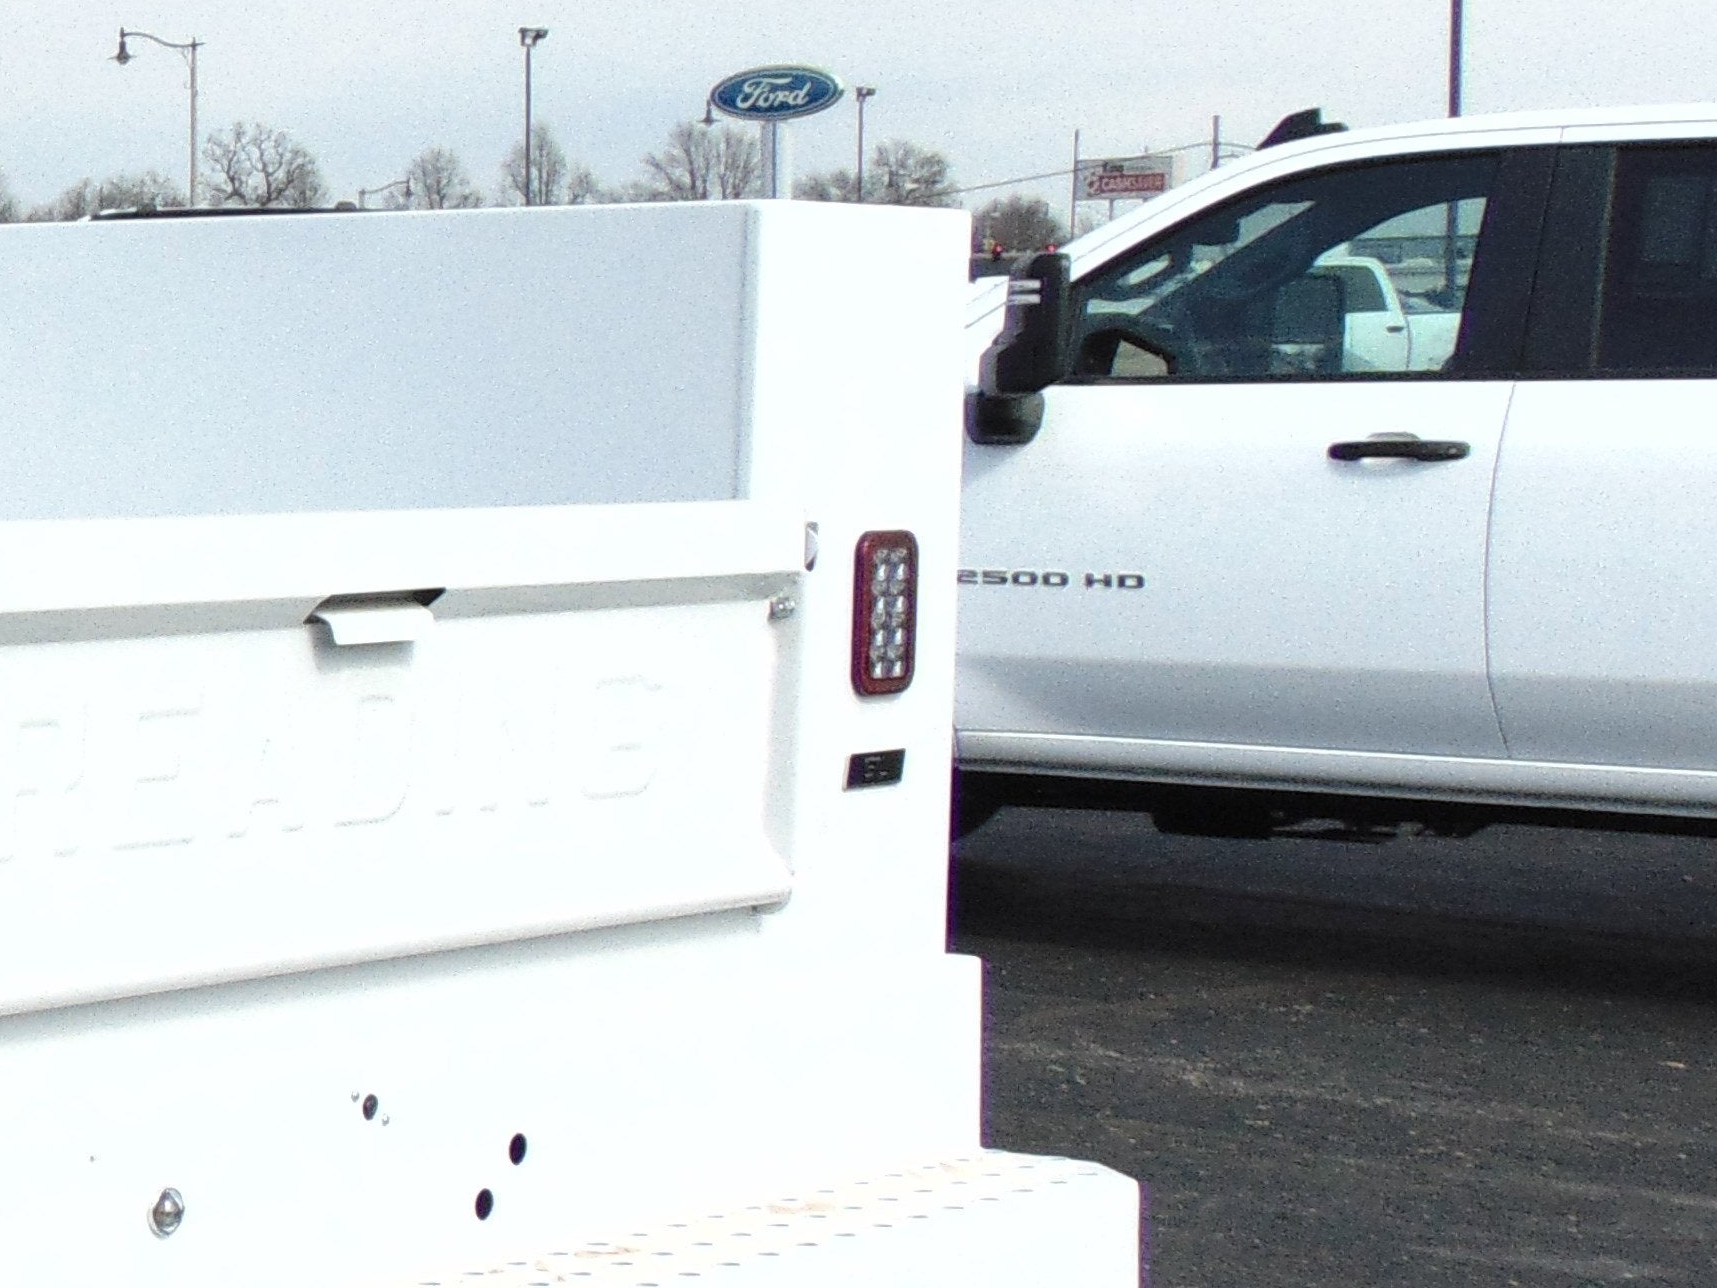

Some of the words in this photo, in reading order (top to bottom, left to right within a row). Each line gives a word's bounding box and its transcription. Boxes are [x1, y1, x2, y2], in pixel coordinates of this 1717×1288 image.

[736, 76, 812, 109] Ford
[957, 569, 1070, 587] 2500
[1084, 572, 1146, 589] HD
